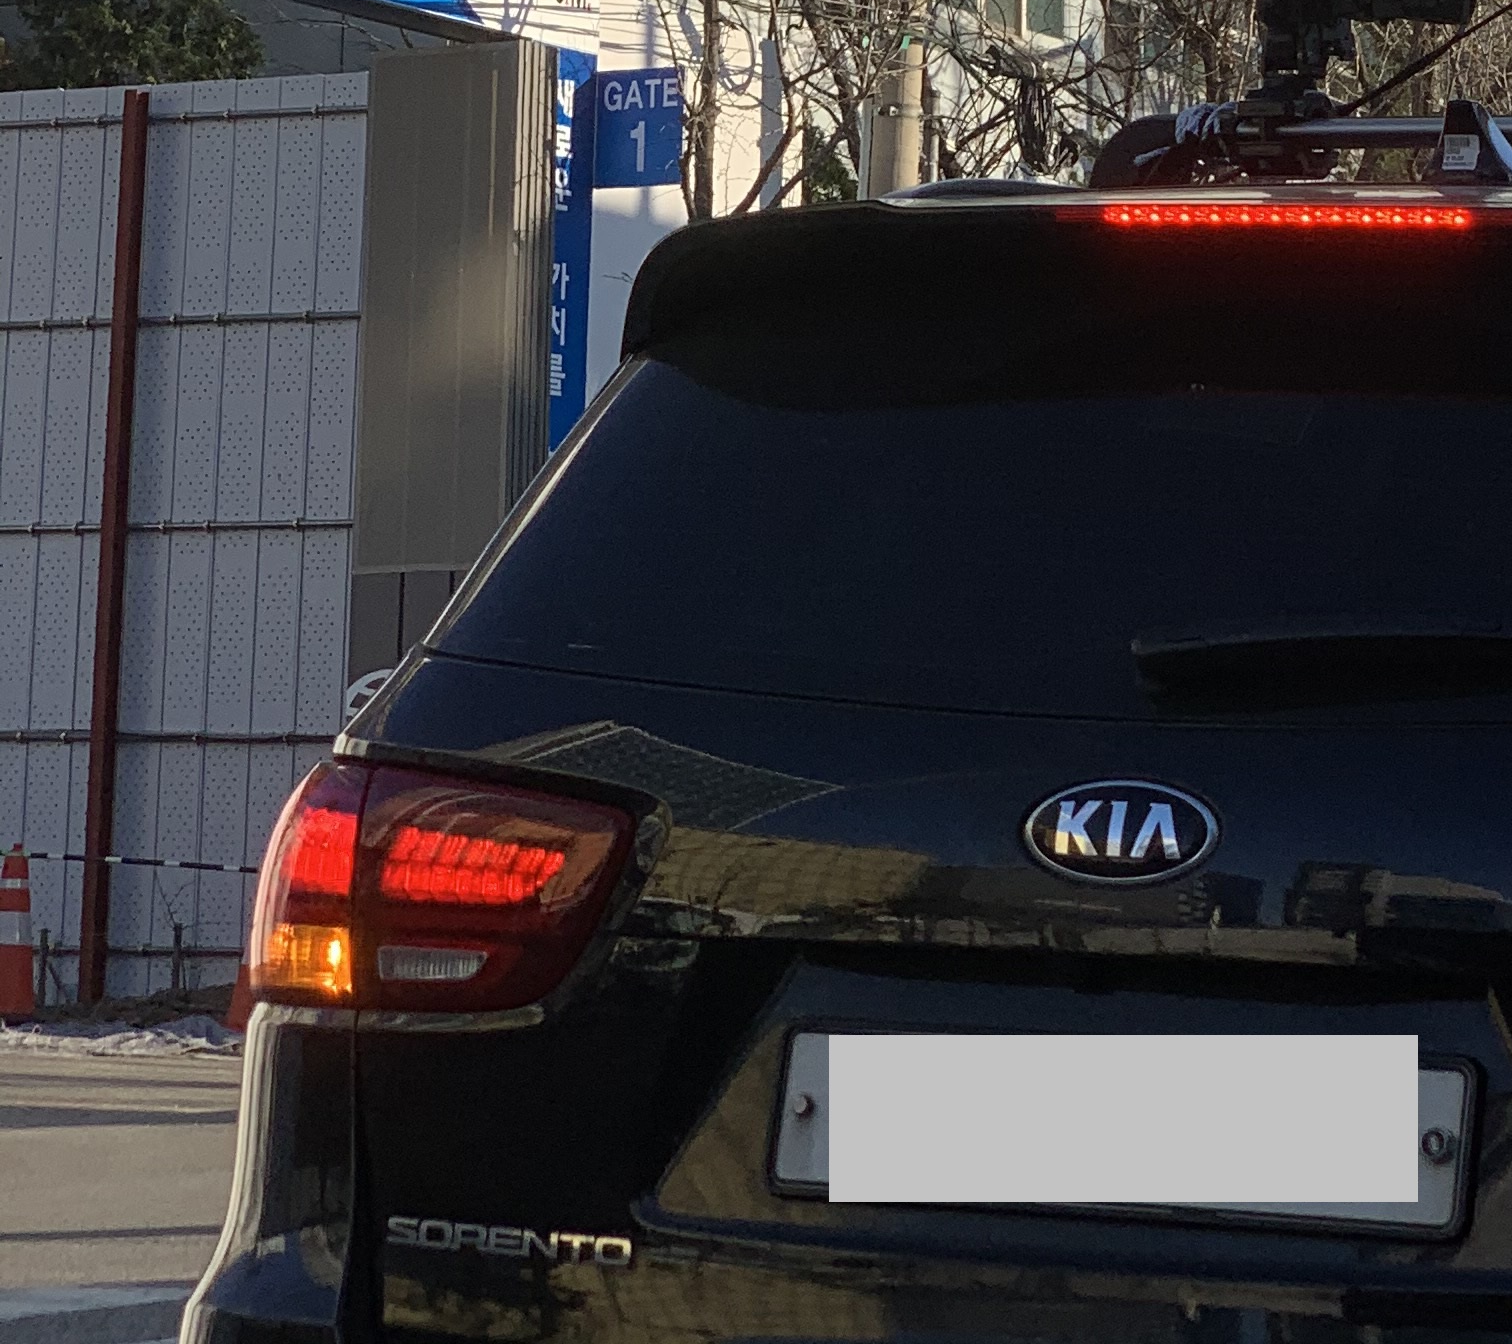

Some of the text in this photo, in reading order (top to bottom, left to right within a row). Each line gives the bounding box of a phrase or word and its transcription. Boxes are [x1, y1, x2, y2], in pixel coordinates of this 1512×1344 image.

[603, 78, 679, 111] GATE
[630, 120, 645, 173] 1
[1054, 799, 1181, 860] KIA
[386, 1215, 633, 1267] SORENTO
